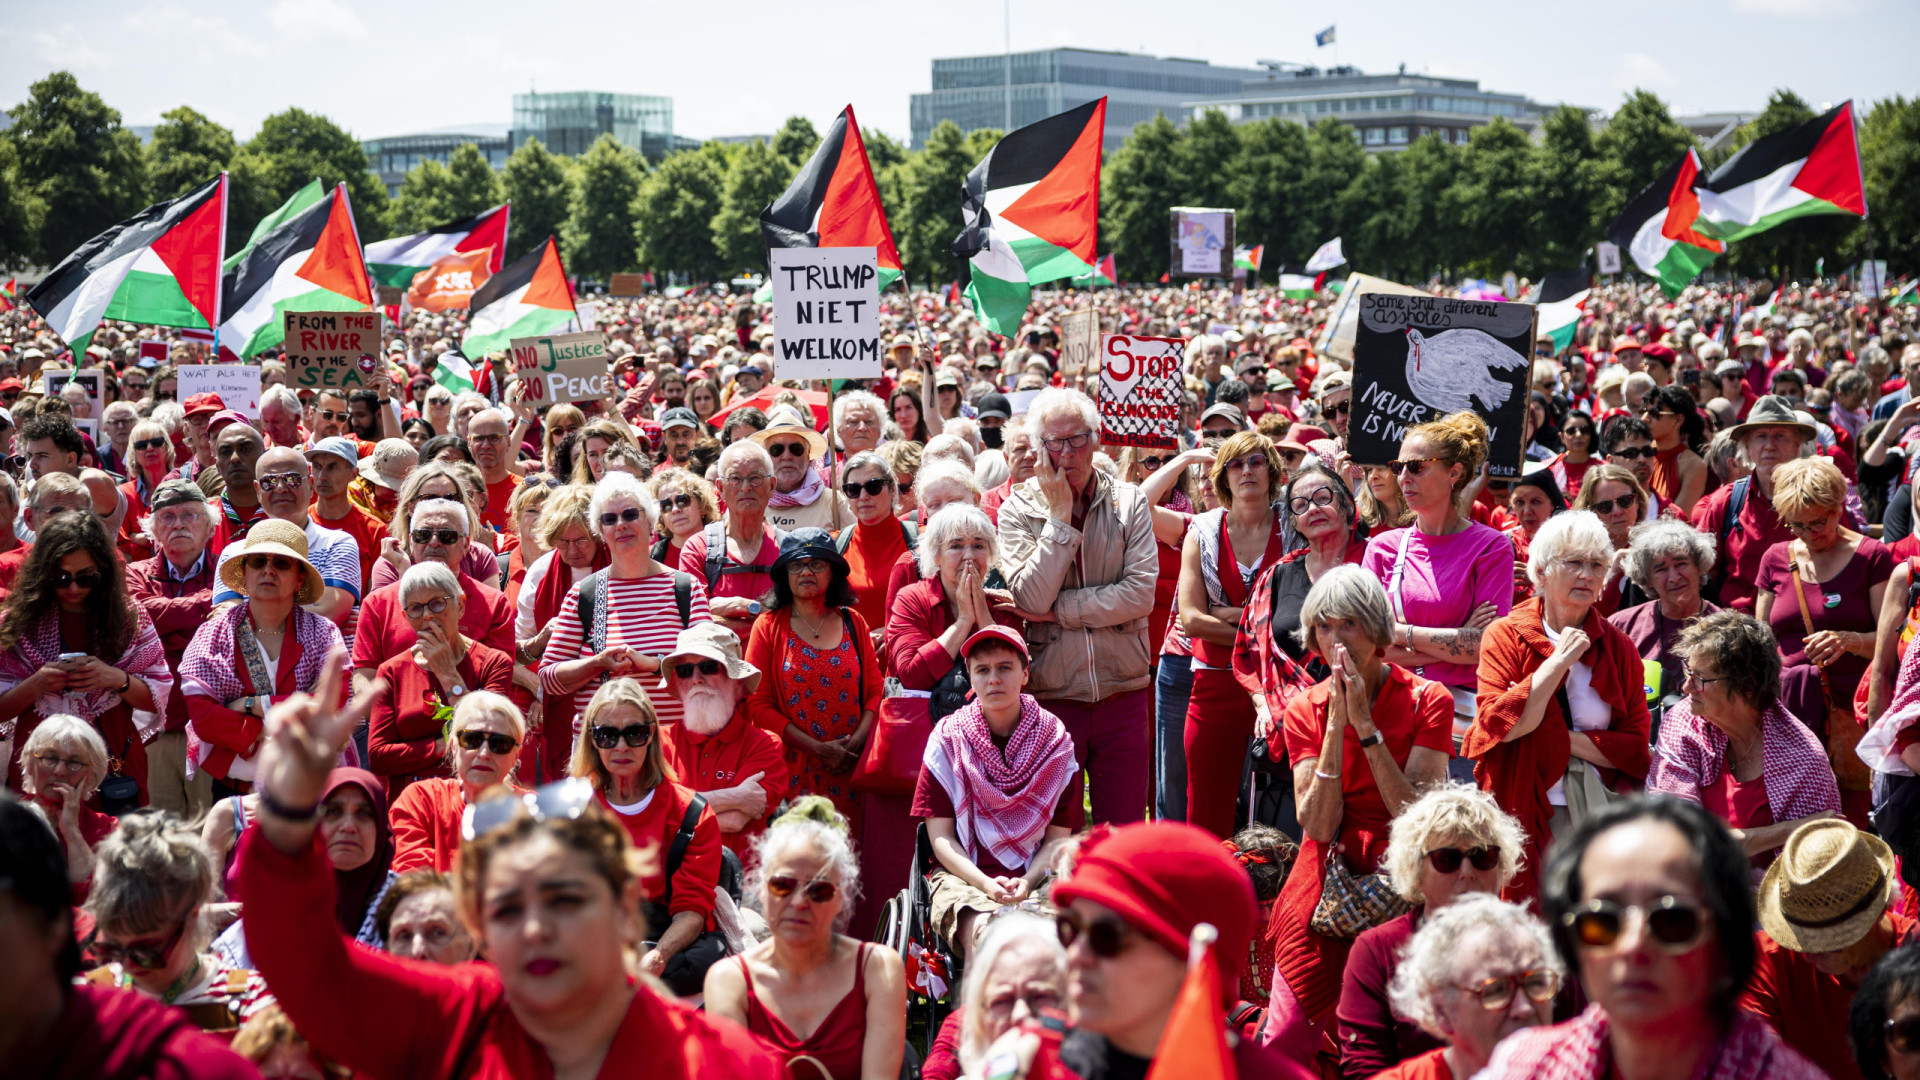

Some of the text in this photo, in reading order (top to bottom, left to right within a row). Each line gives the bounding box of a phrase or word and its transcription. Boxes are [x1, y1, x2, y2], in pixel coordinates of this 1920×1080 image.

[780, 264, 875, 292] TRUMP
[1366, 293, 1405, 310] Same
[1444, 299, 1498, 317] different
[1373, 305, 1451, 327] assholes
[286, 314, 374, 331] FROM THE
[515, 338, 603, 372] NO Justice
[780, 338, 879, 362] WELKOM
[1066, 341, 1097, 365] NOW
[288, 355, 348, 369] TO THE
[184, 369, 210, 378] WAT
[217, 370, 235, 378] ALS
[297, 366, 363, 387] SEA
[518, 373, 611, 402] NO PEACE
[1135, 386, 1165, 400] THE
[1103, 401, 1179, 420] GENOCIDE
[1361, 381, 1427, 423] NEVER
[773, 516, 796, 525] Van
